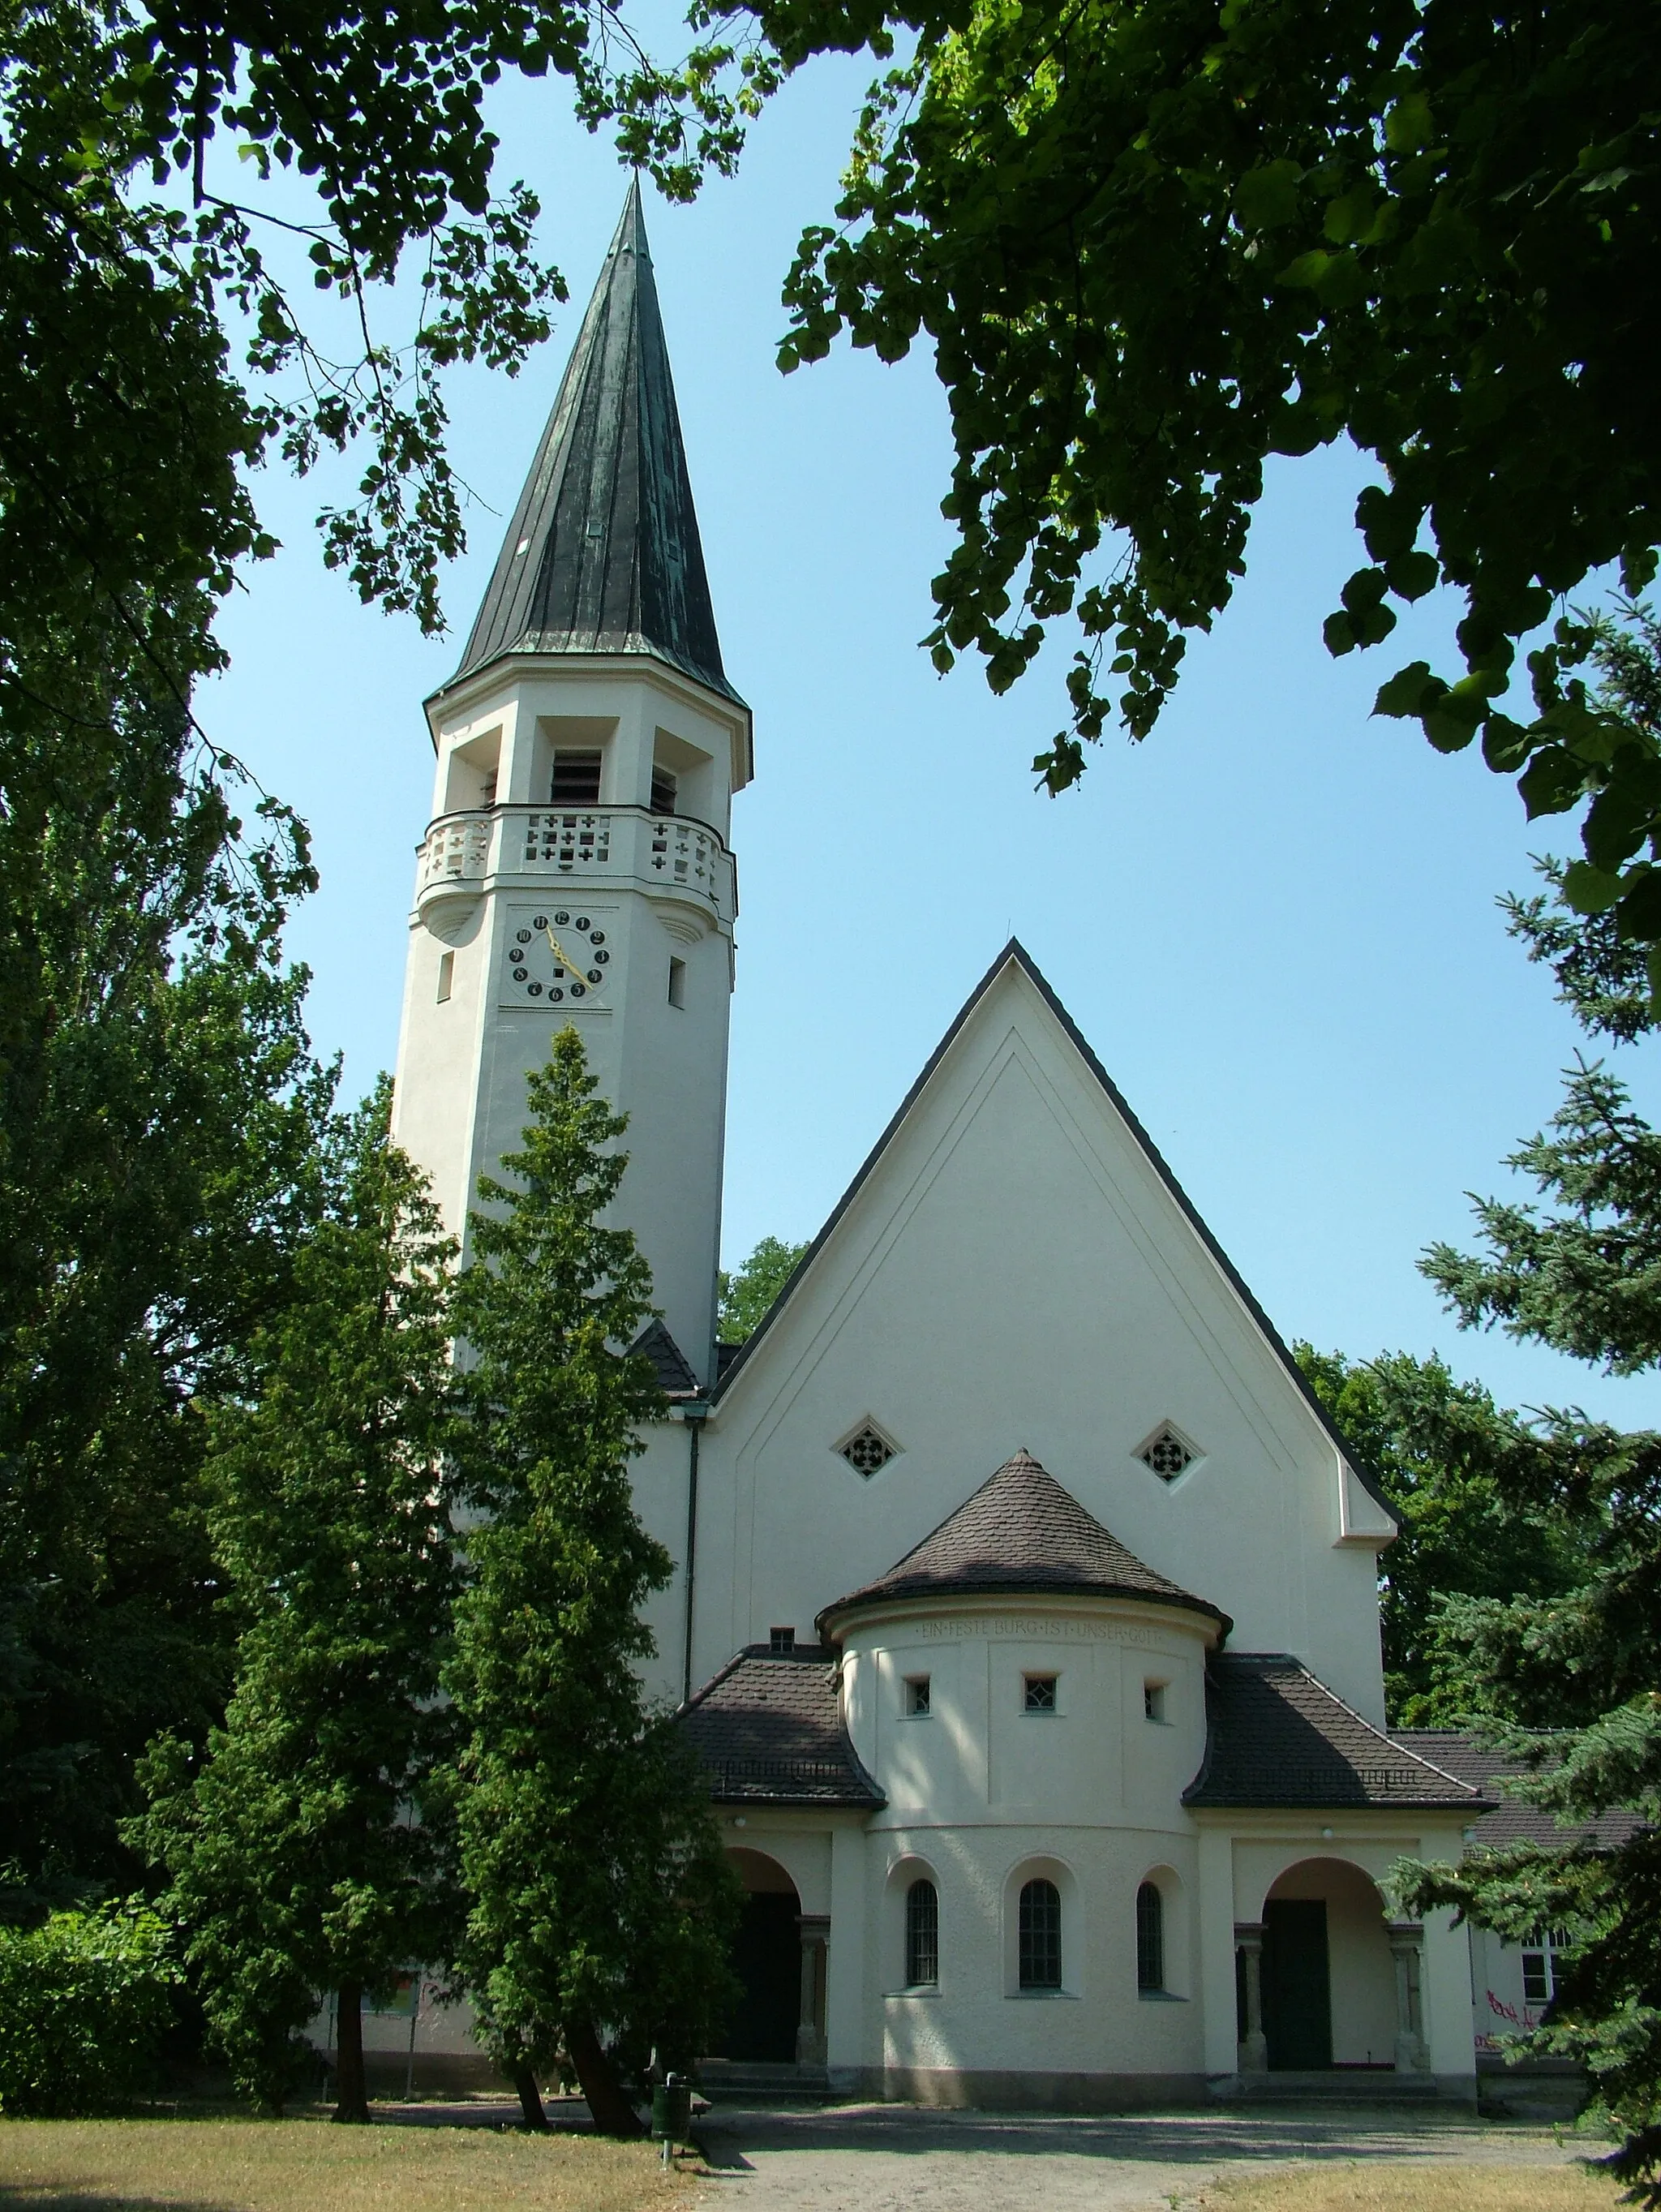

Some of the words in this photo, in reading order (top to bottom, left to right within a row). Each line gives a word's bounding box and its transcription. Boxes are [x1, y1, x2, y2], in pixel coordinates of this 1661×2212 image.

[536, 917, 545, 927] 11
[556, 912, 567, 923] 12
[519, 930, 529, 942] 10
[593, 931, 601, 943] 2
[513, 949, 520, 960] 9
[516, 968, 525, 980] 8
[552, 988, 560, 1000] 6
[922, 1621, 942, 1638] EIN
[994, 1619, 1037, 1634] BURG
[1045, 1619, 1070, 1637] IST
[1076, 1621, 1125, 1640] UNSER
